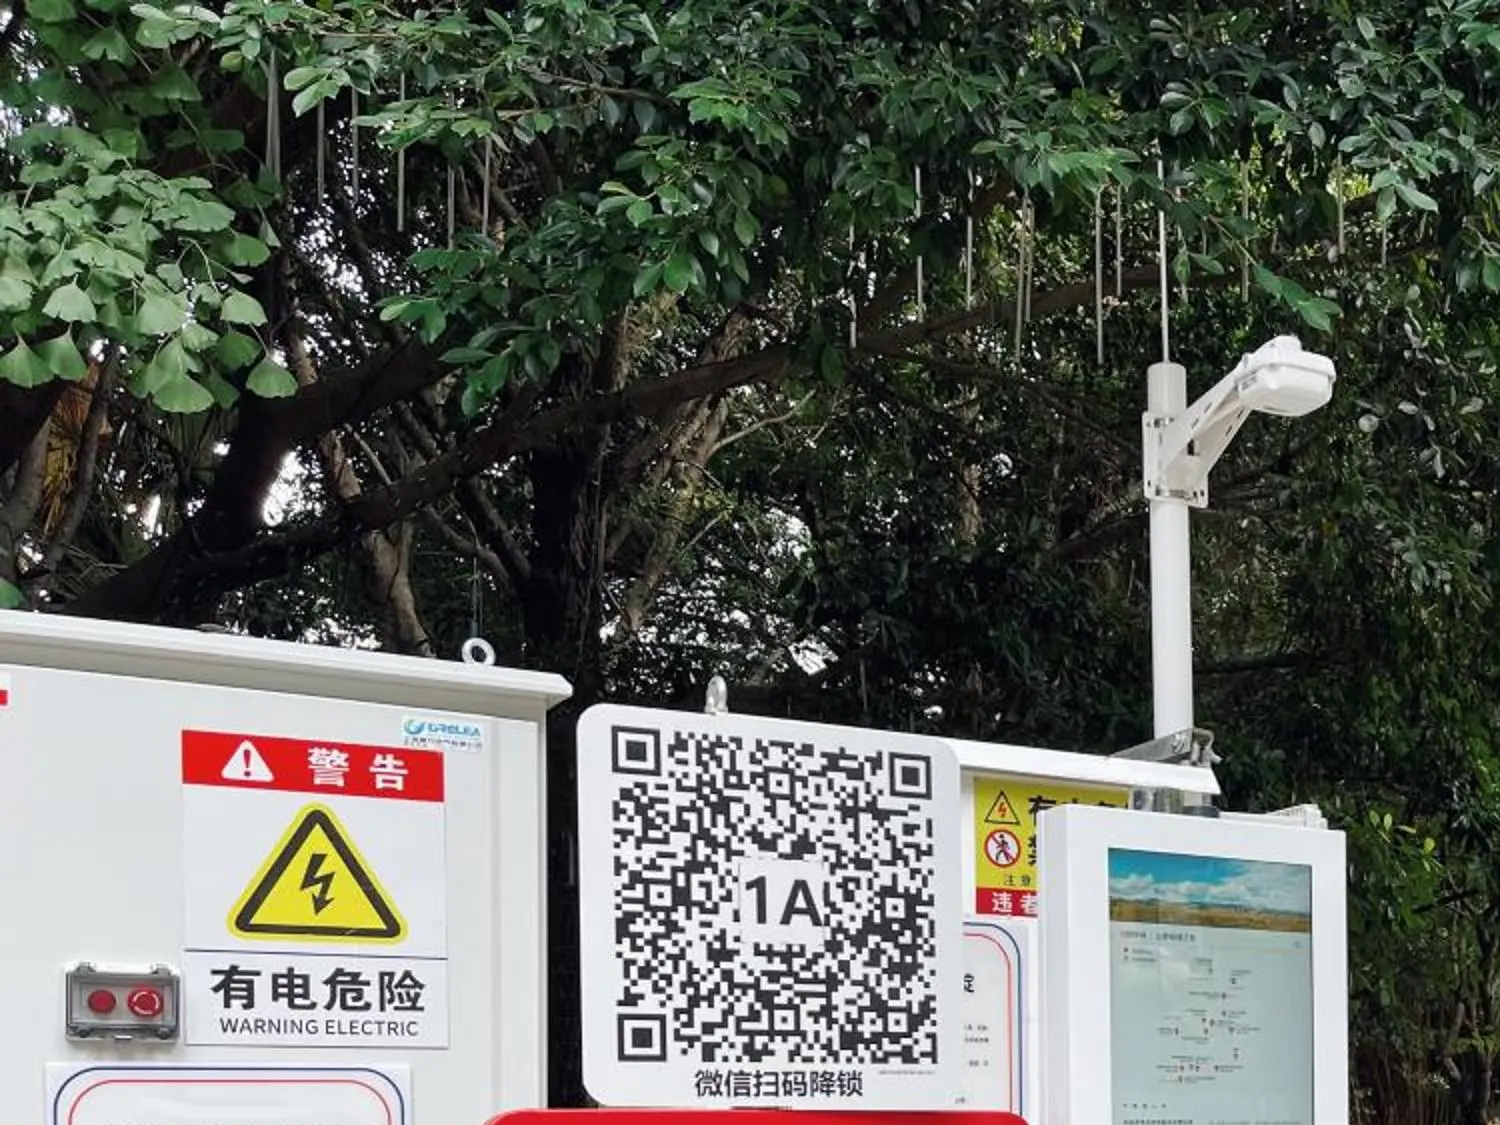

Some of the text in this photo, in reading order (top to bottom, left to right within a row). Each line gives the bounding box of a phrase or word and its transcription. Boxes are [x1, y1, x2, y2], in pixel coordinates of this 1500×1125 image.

[307, 746, 409, 791] 警告
[743, 874, 823, 927] 1A
[210, 964, 426, 1013] 有电危险
[219, 1017, 419, 1037] WARNING ELECTRIC
[694, 1069, 863, 1098] 微信扫码降锁
